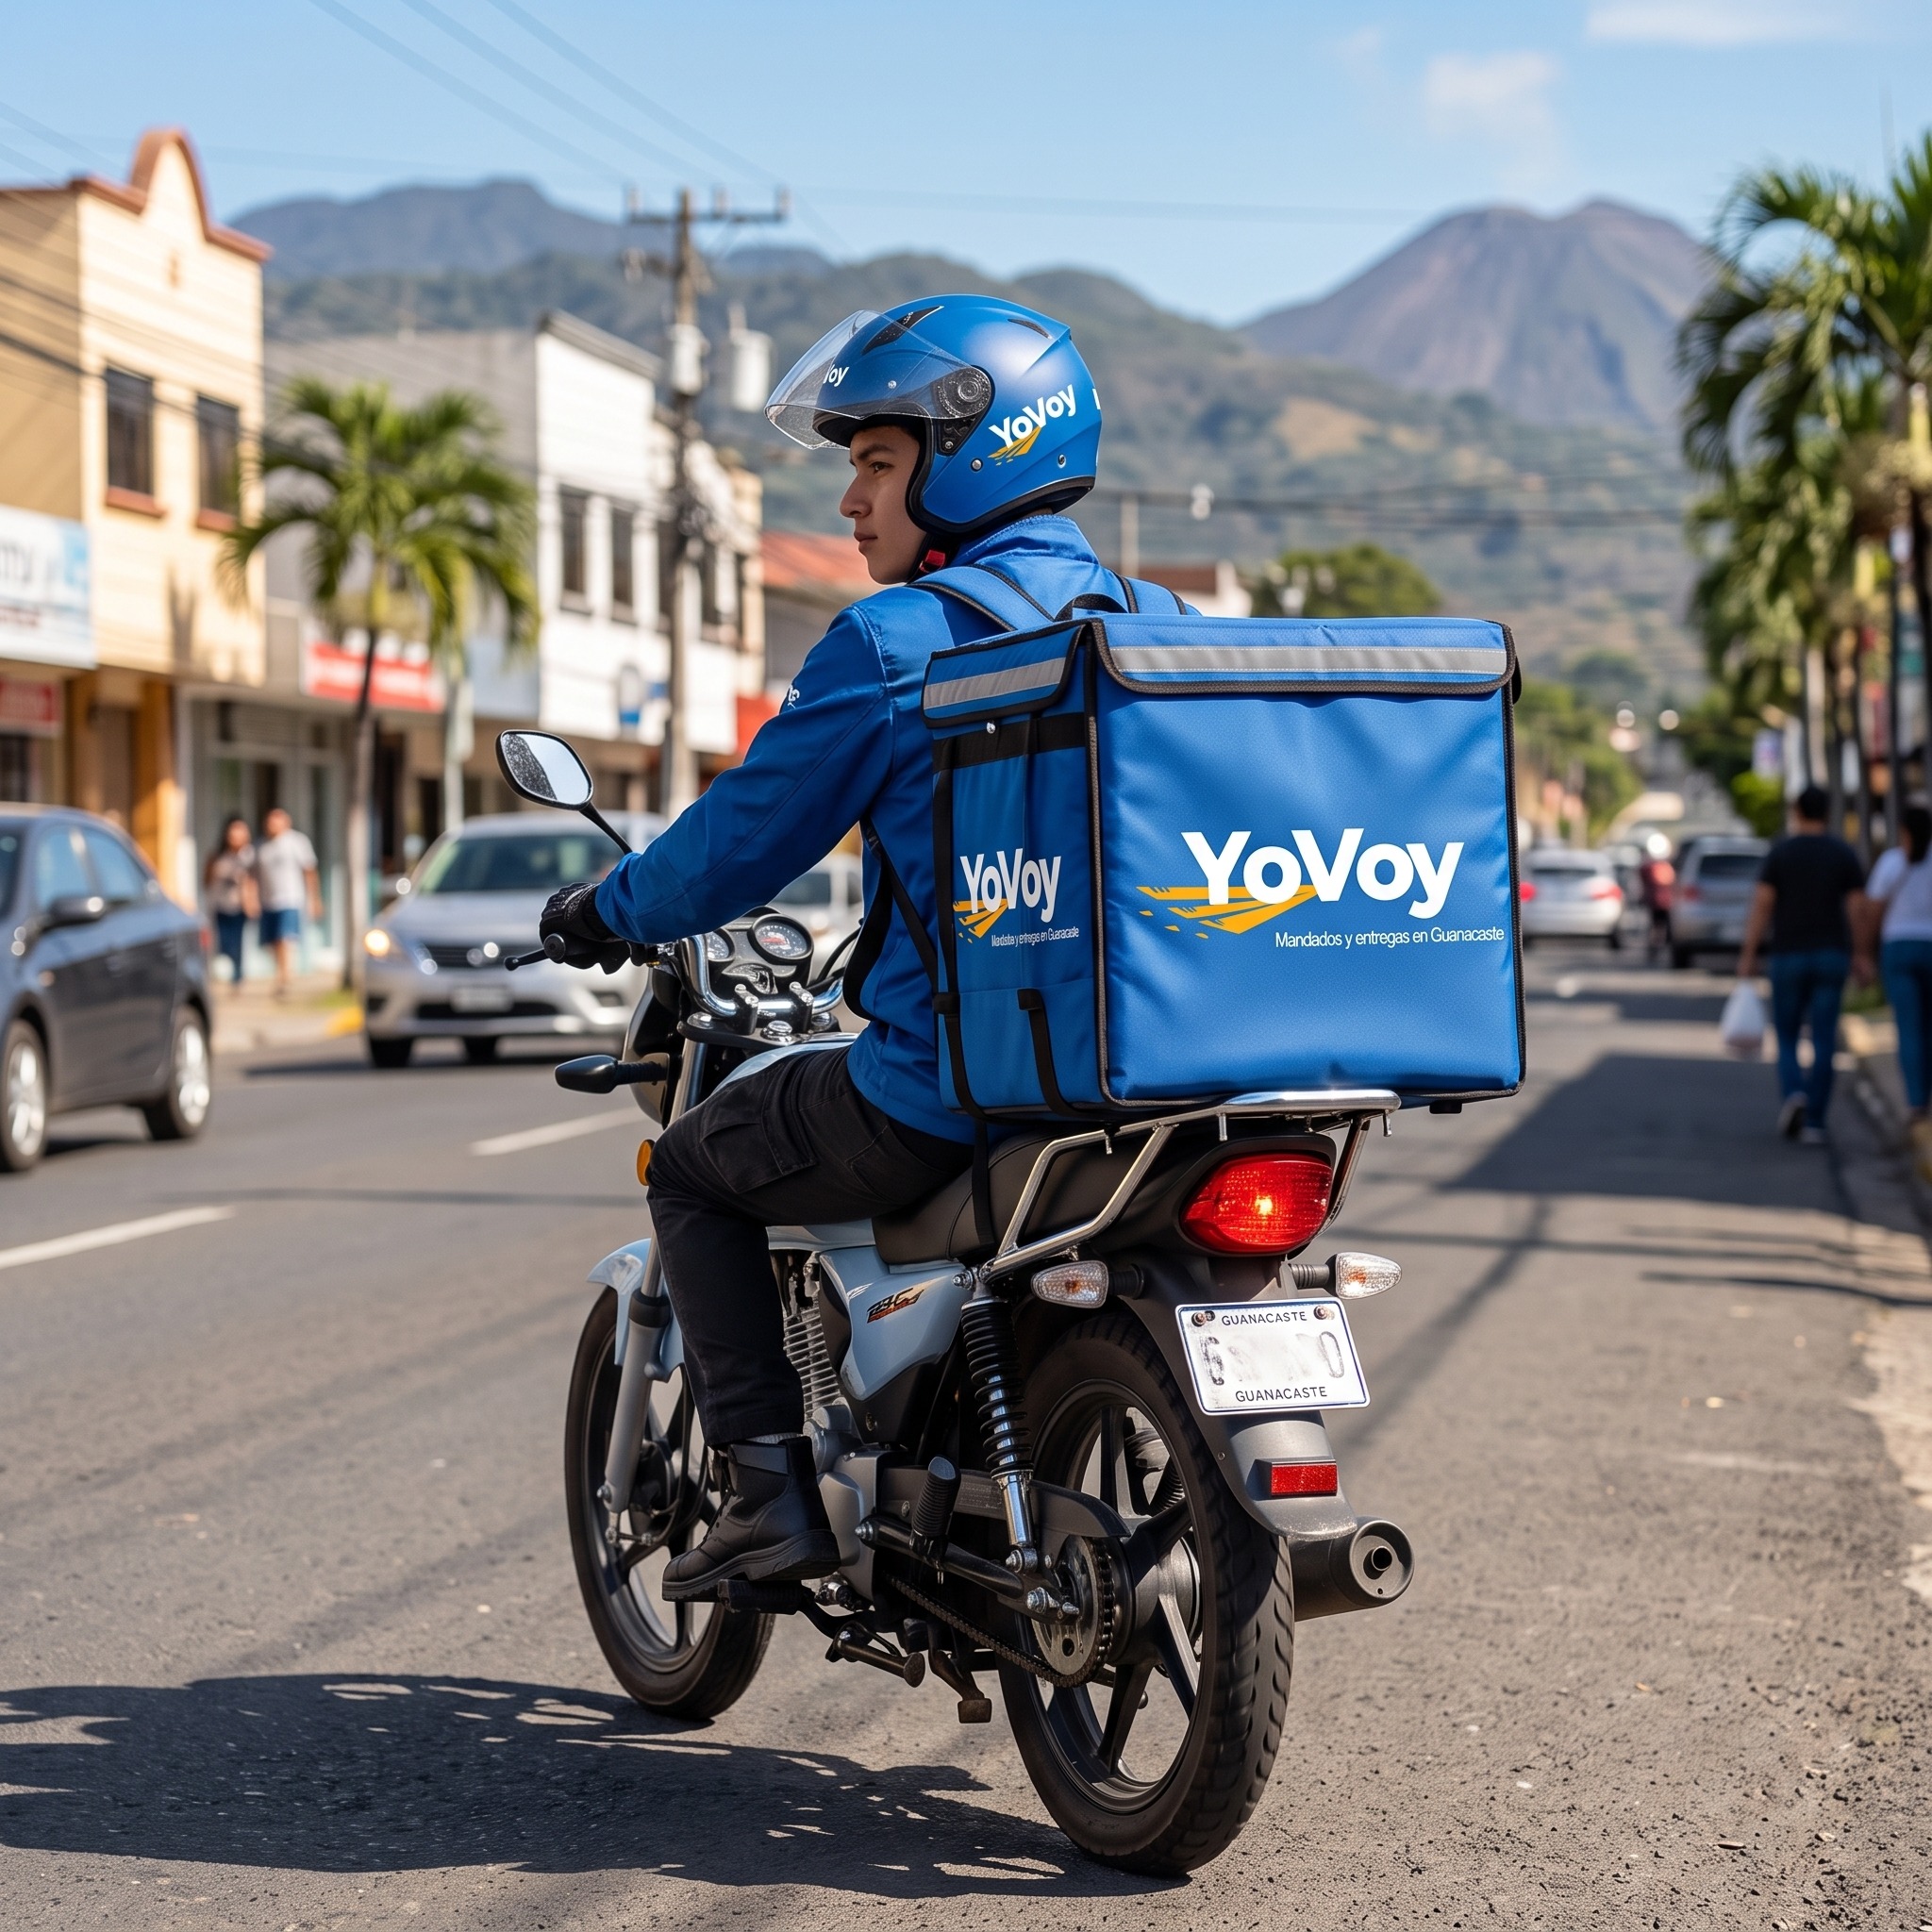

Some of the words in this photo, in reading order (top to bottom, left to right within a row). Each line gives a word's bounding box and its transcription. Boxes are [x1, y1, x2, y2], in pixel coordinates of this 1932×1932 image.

[989, 384, 1075, 448] YoVoy
[959, 847, 1061, 923] YoVoy
[1180, 827, 1464, 919] YoVoy
[1274, 931, 1342, 948] Mandados
[1345, 933, 1353, 950] y
[1356, 930, 1409, 949] entregas
[1412, 930, 1428, 943] en
[1430, 925, 1505, 942] Guanacaste
[1222, 1311, 1307, 1326] GUANACASTE
[1235, 1386, 1327, 1403] GUANACASTE
